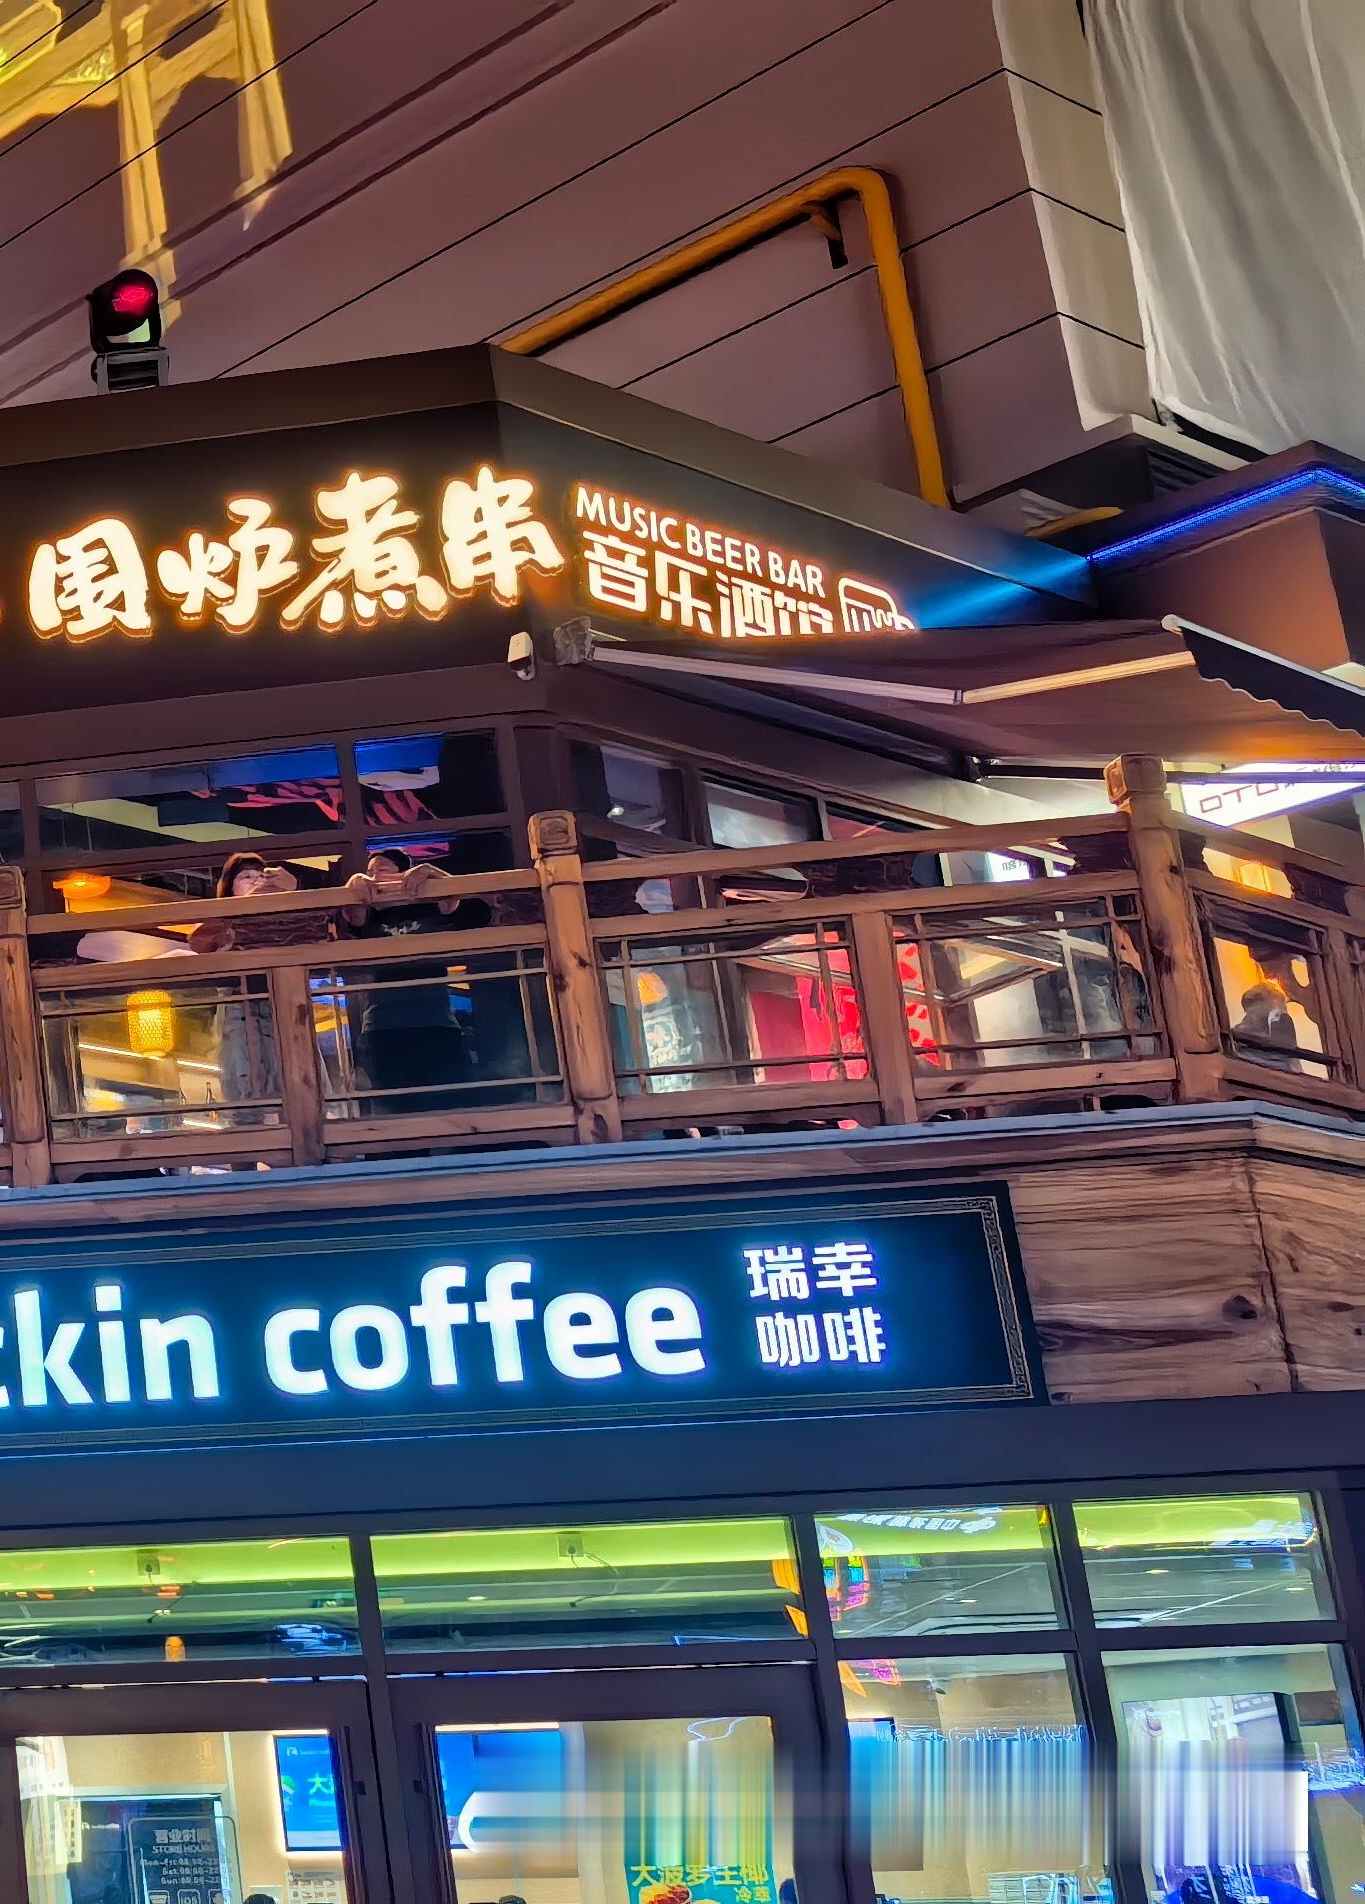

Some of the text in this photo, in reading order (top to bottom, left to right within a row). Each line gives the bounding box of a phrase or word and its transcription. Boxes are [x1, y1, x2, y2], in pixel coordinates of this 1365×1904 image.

[29, 467, 564, 635] 围炉煮串
[576, 486, 826, 599] MUSIC BEER BAR
[263, 1260, 707, 1395] coffee
[743, 1241, 877, 1301] 瑞幸
[755, 1306, 886, 1368] 咖啡
